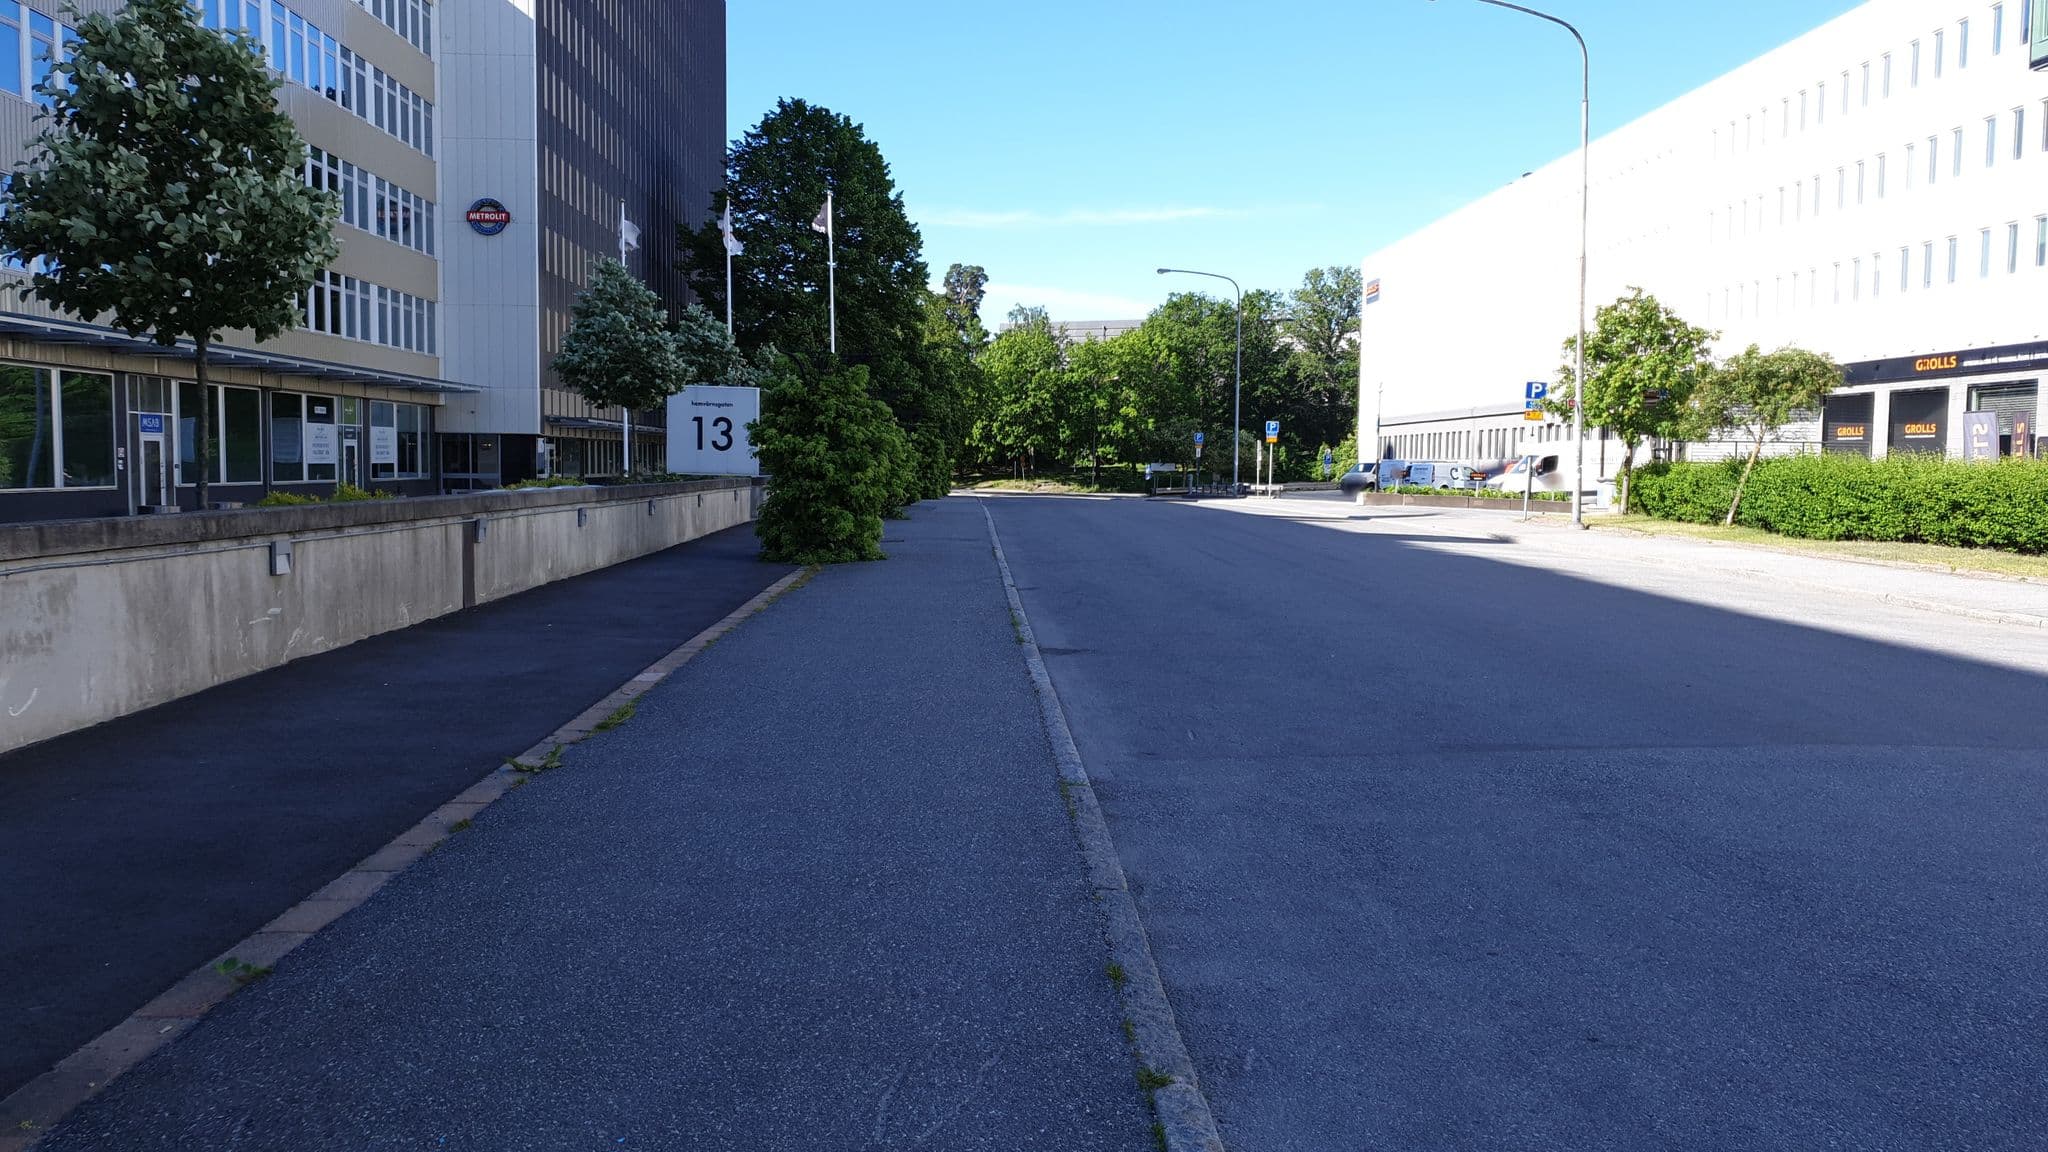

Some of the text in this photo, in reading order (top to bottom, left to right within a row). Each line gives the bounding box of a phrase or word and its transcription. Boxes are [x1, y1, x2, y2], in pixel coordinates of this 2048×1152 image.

[469, 212, 506, 220] METROLIT
[1915, 356, 1957, 371] GROLLS
[1531, 383, 1543, 398] P
[691, 416, 733, 452] 13
[1837, 426, 1865, 436] GROLLS
[1904, 423, 1937, 434] GROLLS
